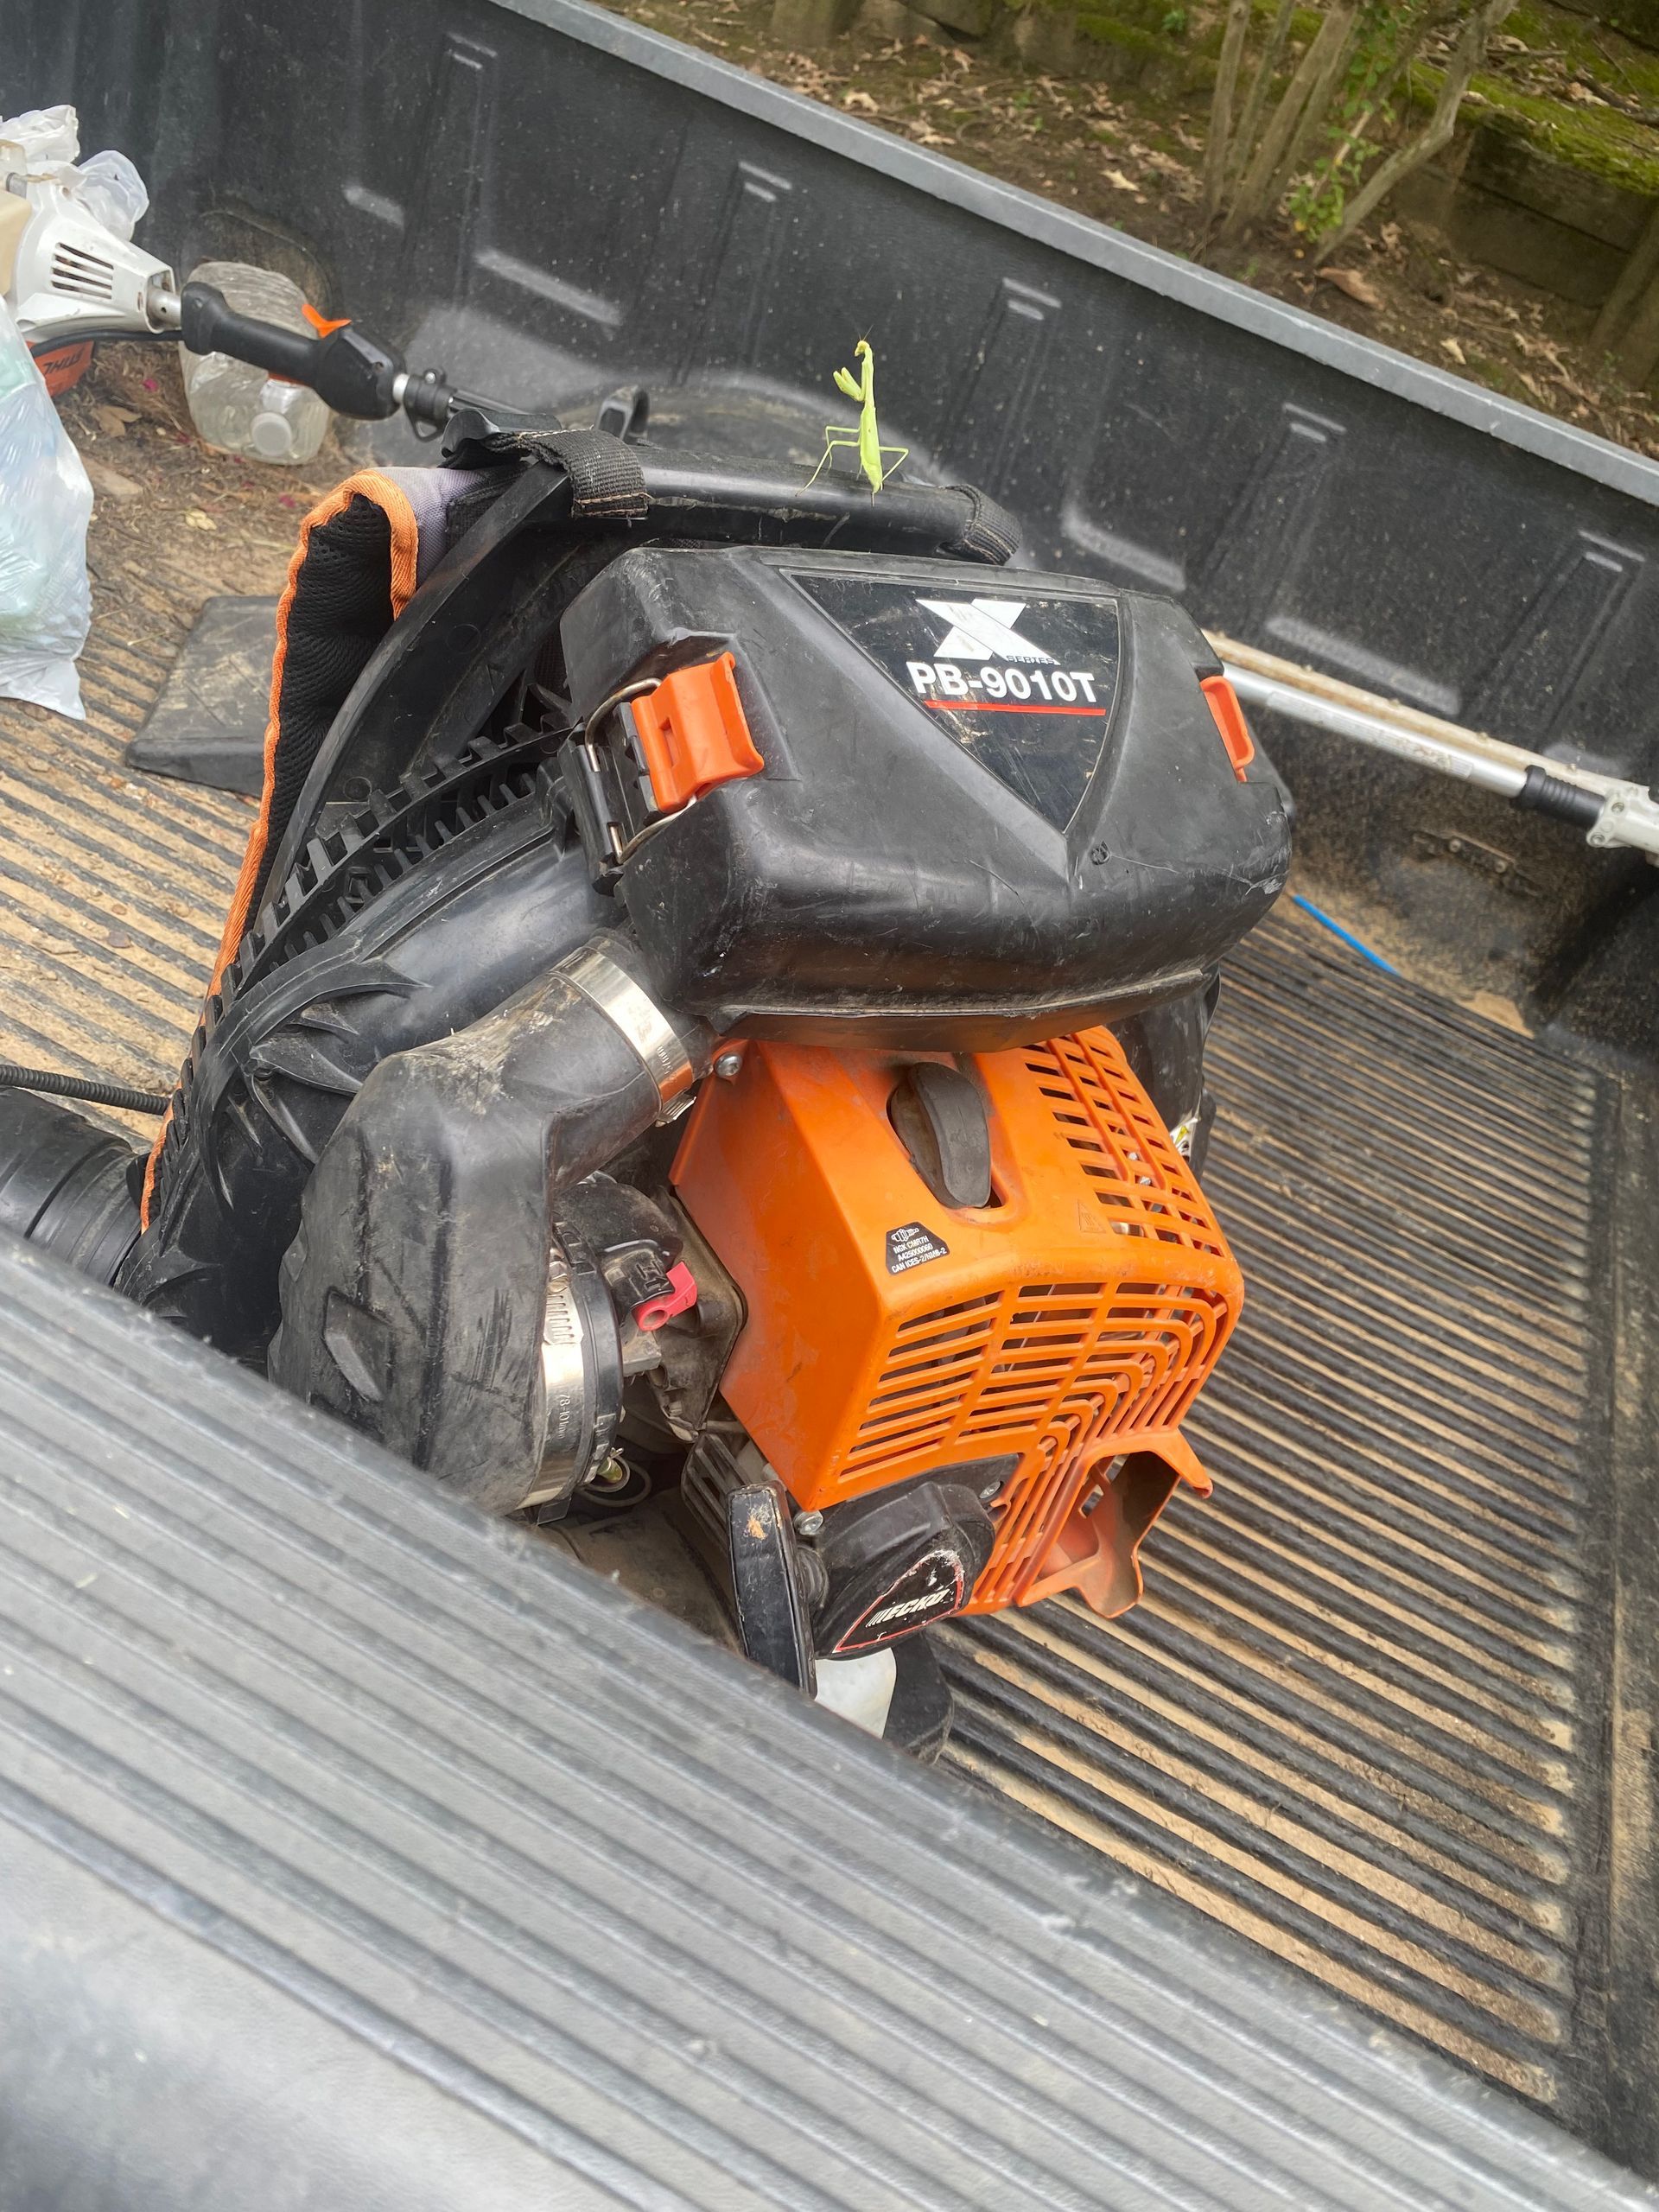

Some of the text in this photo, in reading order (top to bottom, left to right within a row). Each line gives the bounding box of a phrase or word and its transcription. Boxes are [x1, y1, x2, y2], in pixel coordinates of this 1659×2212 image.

[906, 662, 1096, 703] PB-9010T
[893, 1236, 929, 1254] NGK CMR7H
[891, 1262, 906, 1274] CAN
